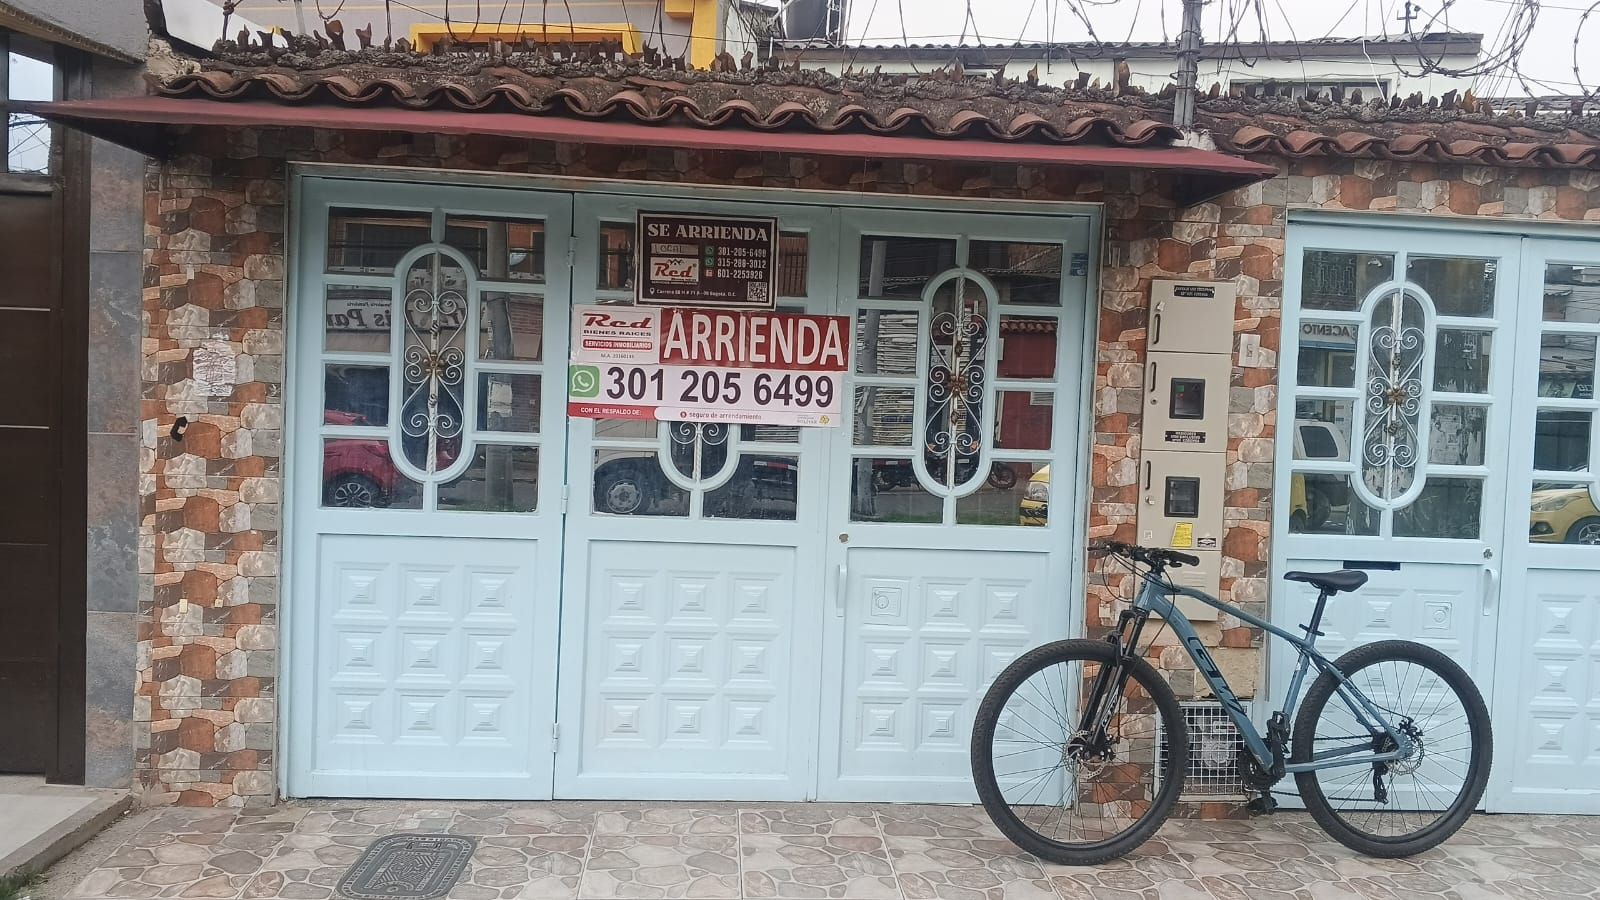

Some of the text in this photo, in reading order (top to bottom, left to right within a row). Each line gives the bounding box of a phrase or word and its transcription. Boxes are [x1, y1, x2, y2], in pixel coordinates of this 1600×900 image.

[647, 223, 769, 242] SE ARRIENDA
[653, 262, 693, 278] Red
[582, 313, 652, 329] Red
[585, 340, 652, 349] SERVICIOS INMOBILIARIOS
[663, 312, 845, 366] ARRIENDA
[606, 366, 834, 408] 301 205 6499
[689, 411, 710, 419] seguro
[719, 412, 762, 420] arrendamiento
